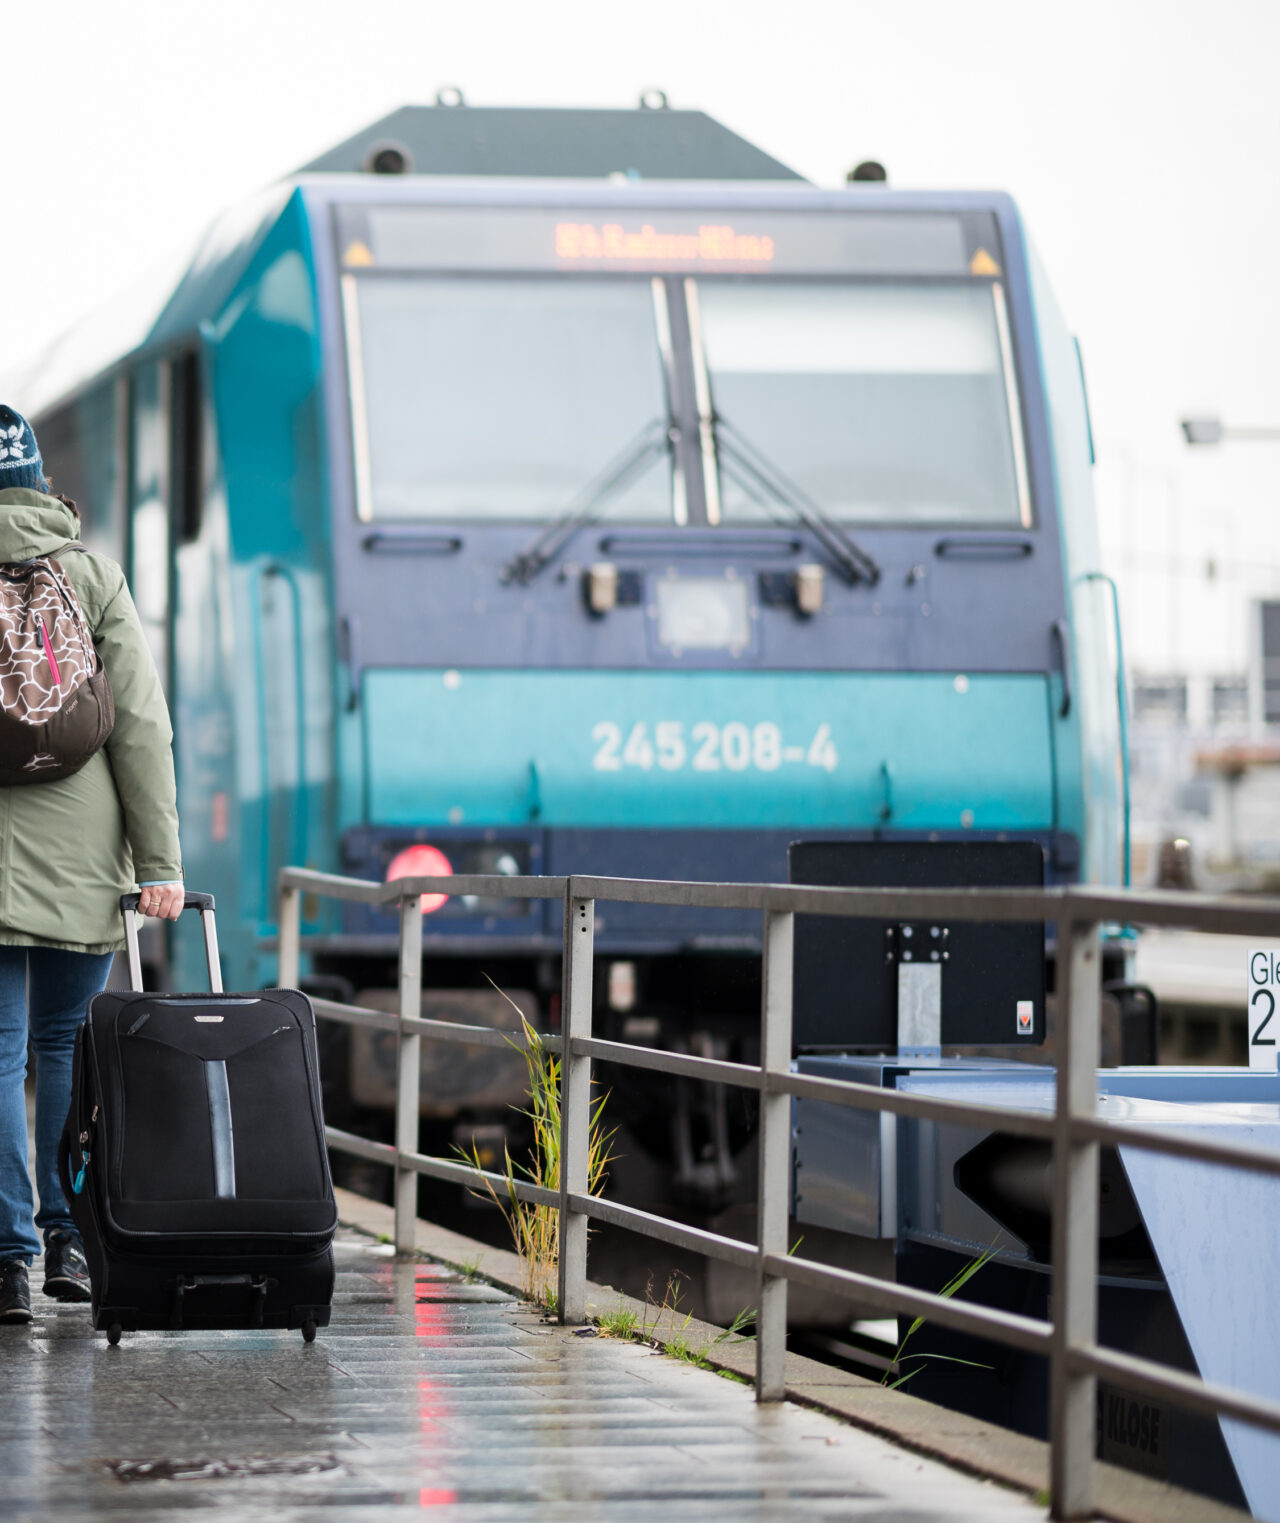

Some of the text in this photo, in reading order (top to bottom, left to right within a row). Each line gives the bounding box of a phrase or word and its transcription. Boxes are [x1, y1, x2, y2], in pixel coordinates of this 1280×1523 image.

[593, 721, 838, 773] 245 208-4
[1251, 989, 1276, 1046] 2
[1108, 1394, 1160, 1456] KLOSE
